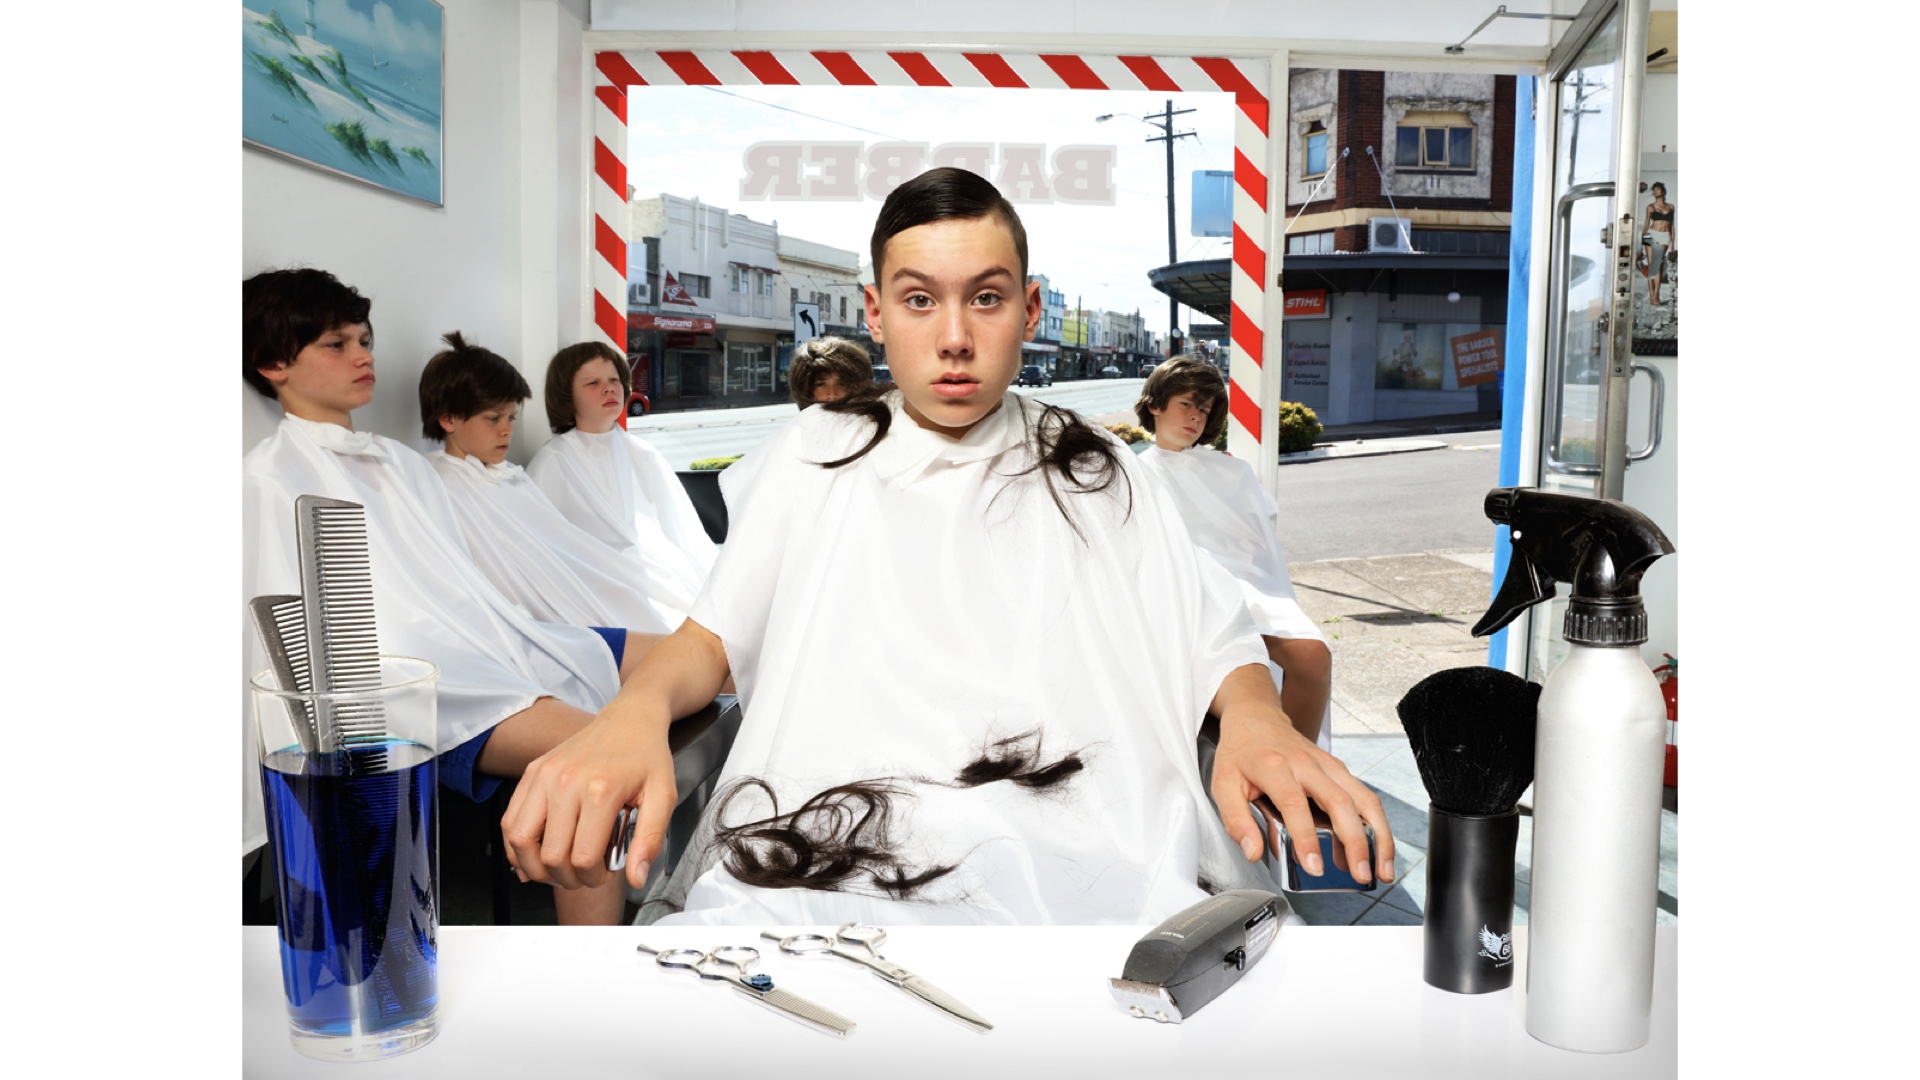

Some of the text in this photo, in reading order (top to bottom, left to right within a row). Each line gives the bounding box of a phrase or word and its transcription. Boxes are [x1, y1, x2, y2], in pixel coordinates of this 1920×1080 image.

[1286, 297, 1320, 308] STIHL
[1456, 336, 1495, 353] THE GARDEN
[1458, 348, 1498, 366] POWER TOOL
